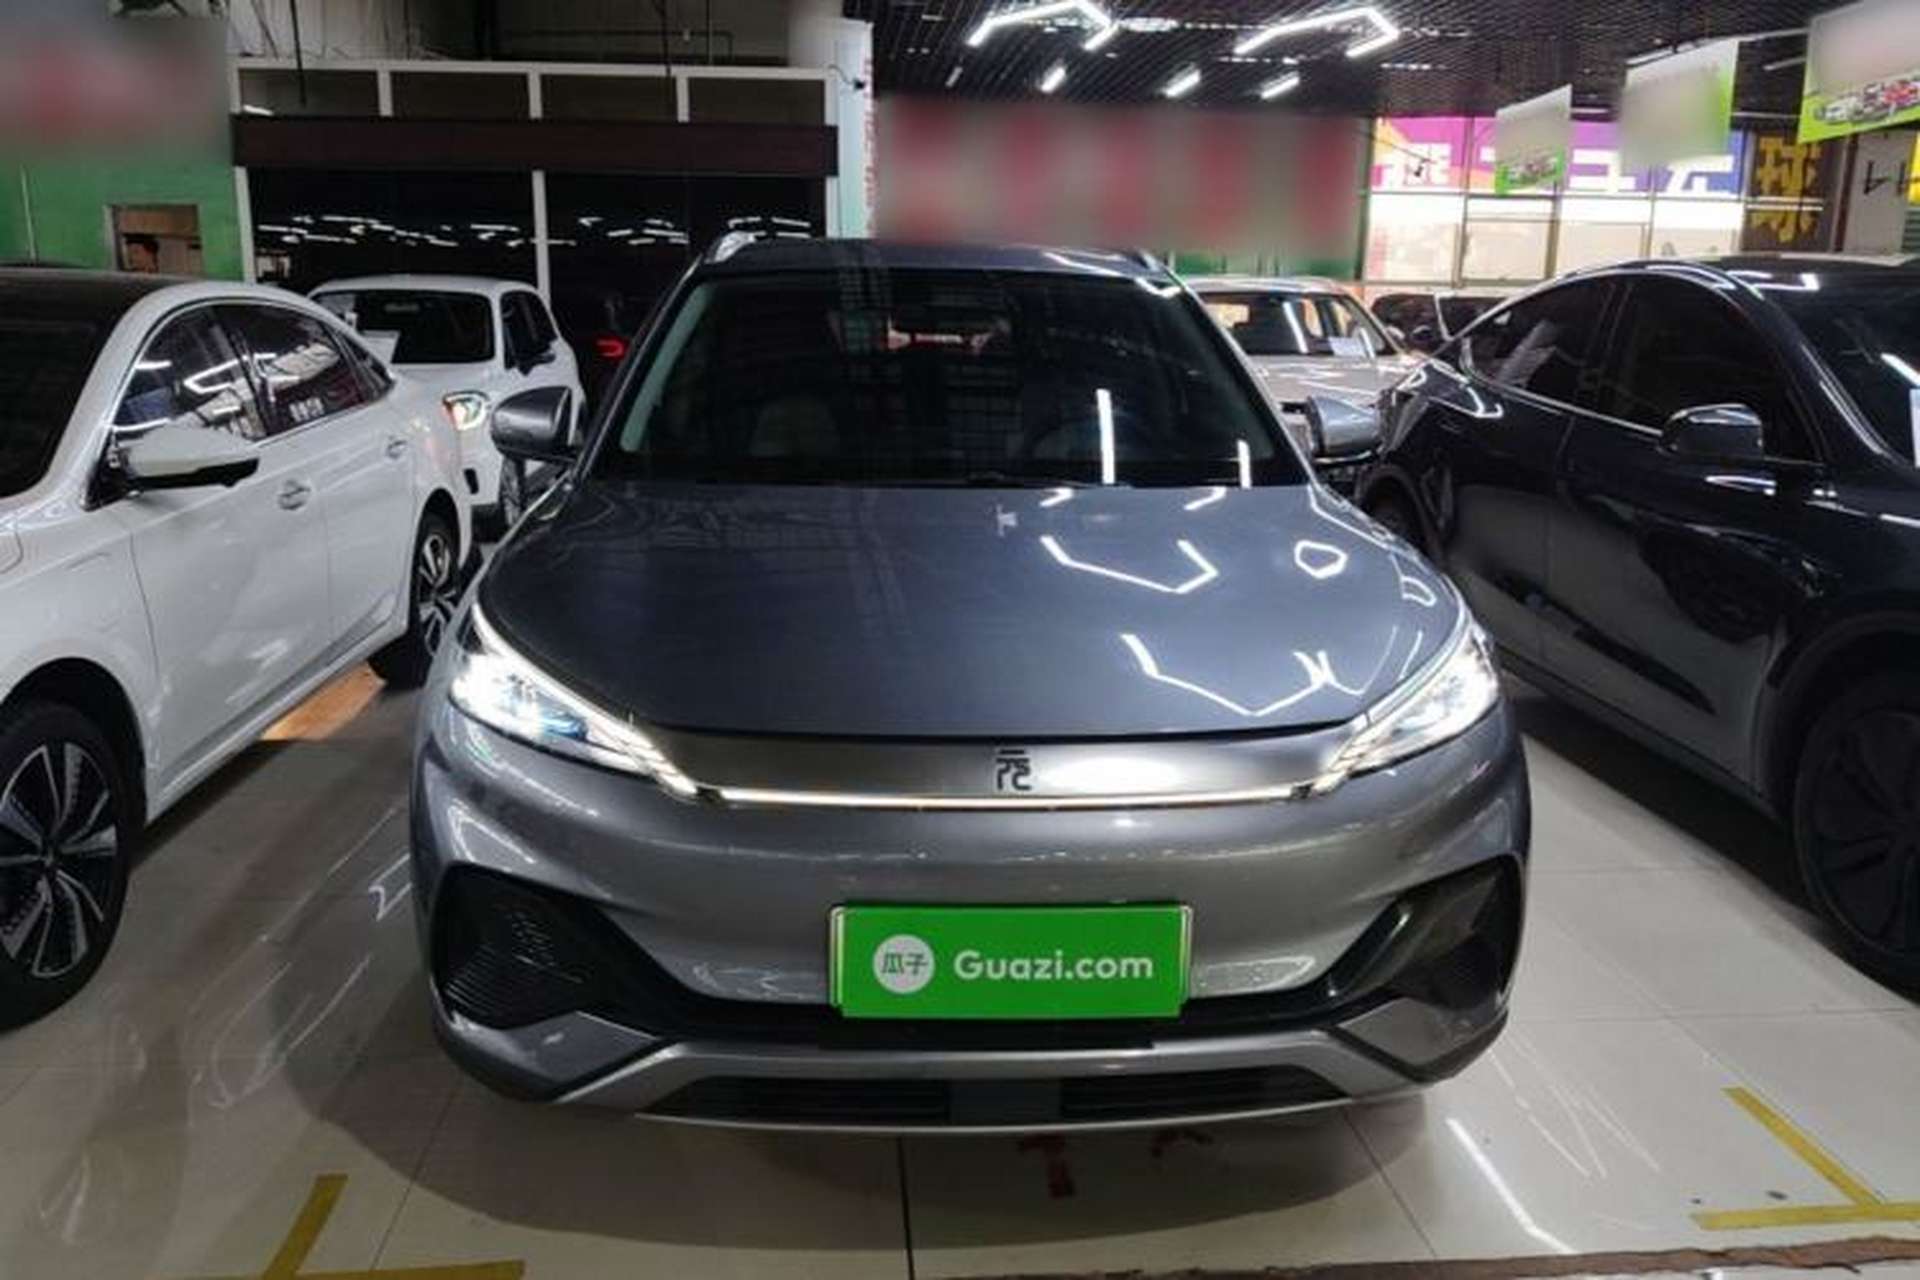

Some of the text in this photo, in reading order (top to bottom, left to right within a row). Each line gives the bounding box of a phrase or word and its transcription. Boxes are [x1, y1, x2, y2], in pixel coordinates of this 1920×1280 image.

[995, 748, 1033, 791] 元
[881, 952, 929, 976] 瓜子
[953, 949, 1154, 981] Guazi.com
